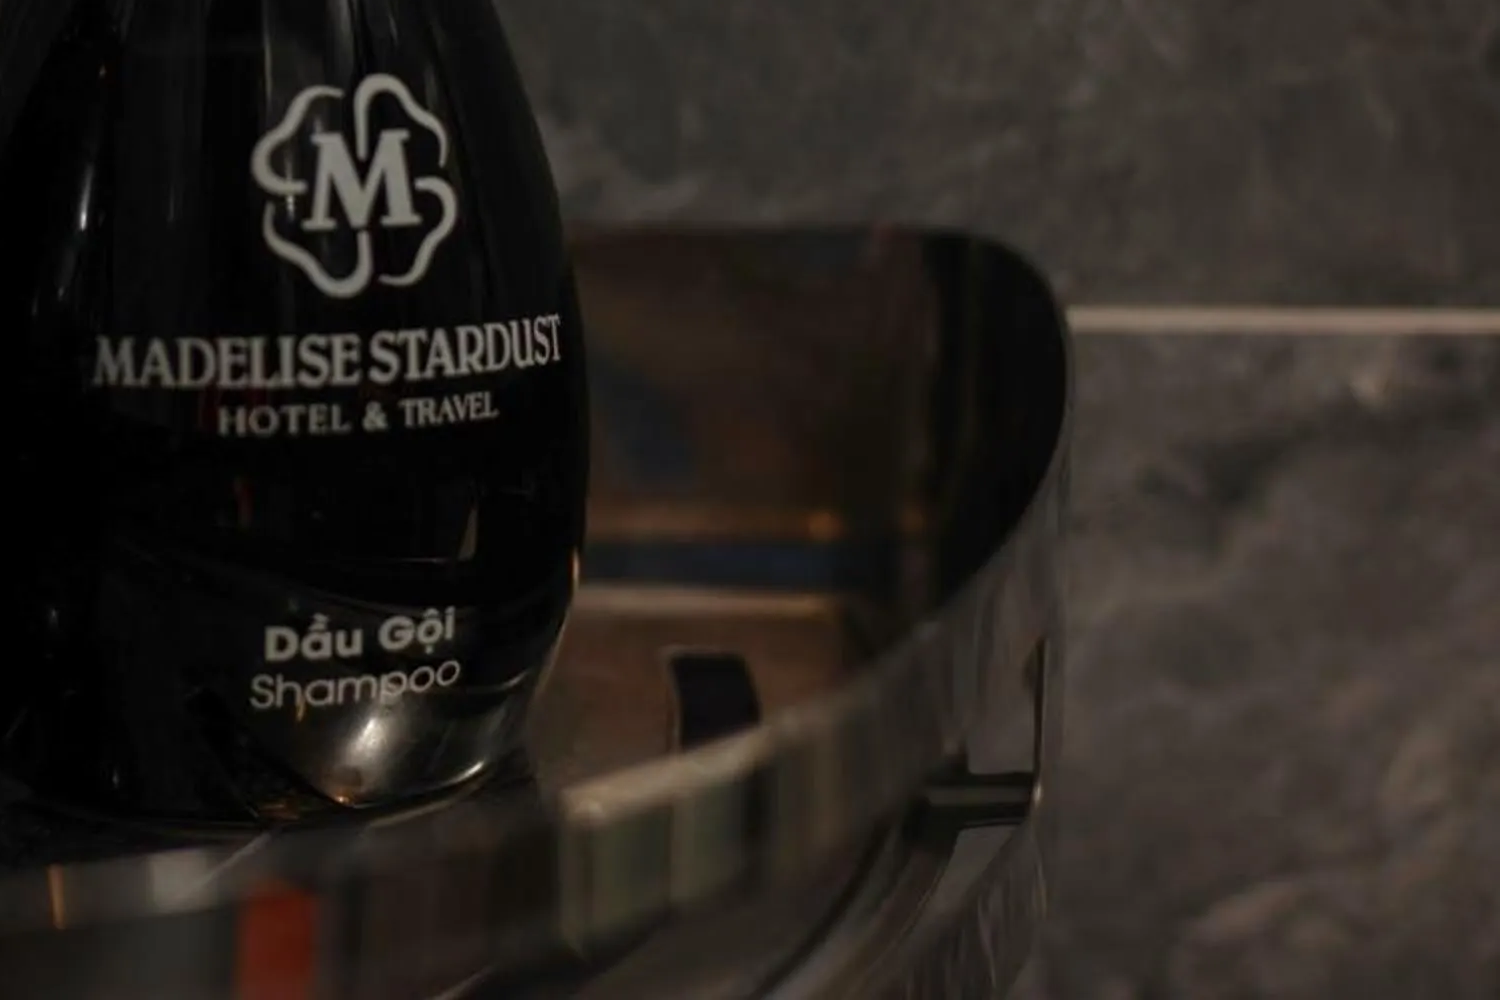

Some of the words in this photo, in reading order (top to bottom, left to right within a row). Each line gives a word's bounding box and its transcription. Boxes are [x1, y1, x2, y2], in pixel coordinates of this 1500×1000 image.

[302, 130, 422, 231] M
[93, 334, 361, 390] MADELISE
[368, 314, 562, 384] STARDUST
[217, 404, 351, 437] HOTEL
[362, 402, 388, 431] &
[400, 391, 499, 429] TRAVEL
[378, 606, 456, 655] Gội
[250, 660, 461, 710] Shampoo
